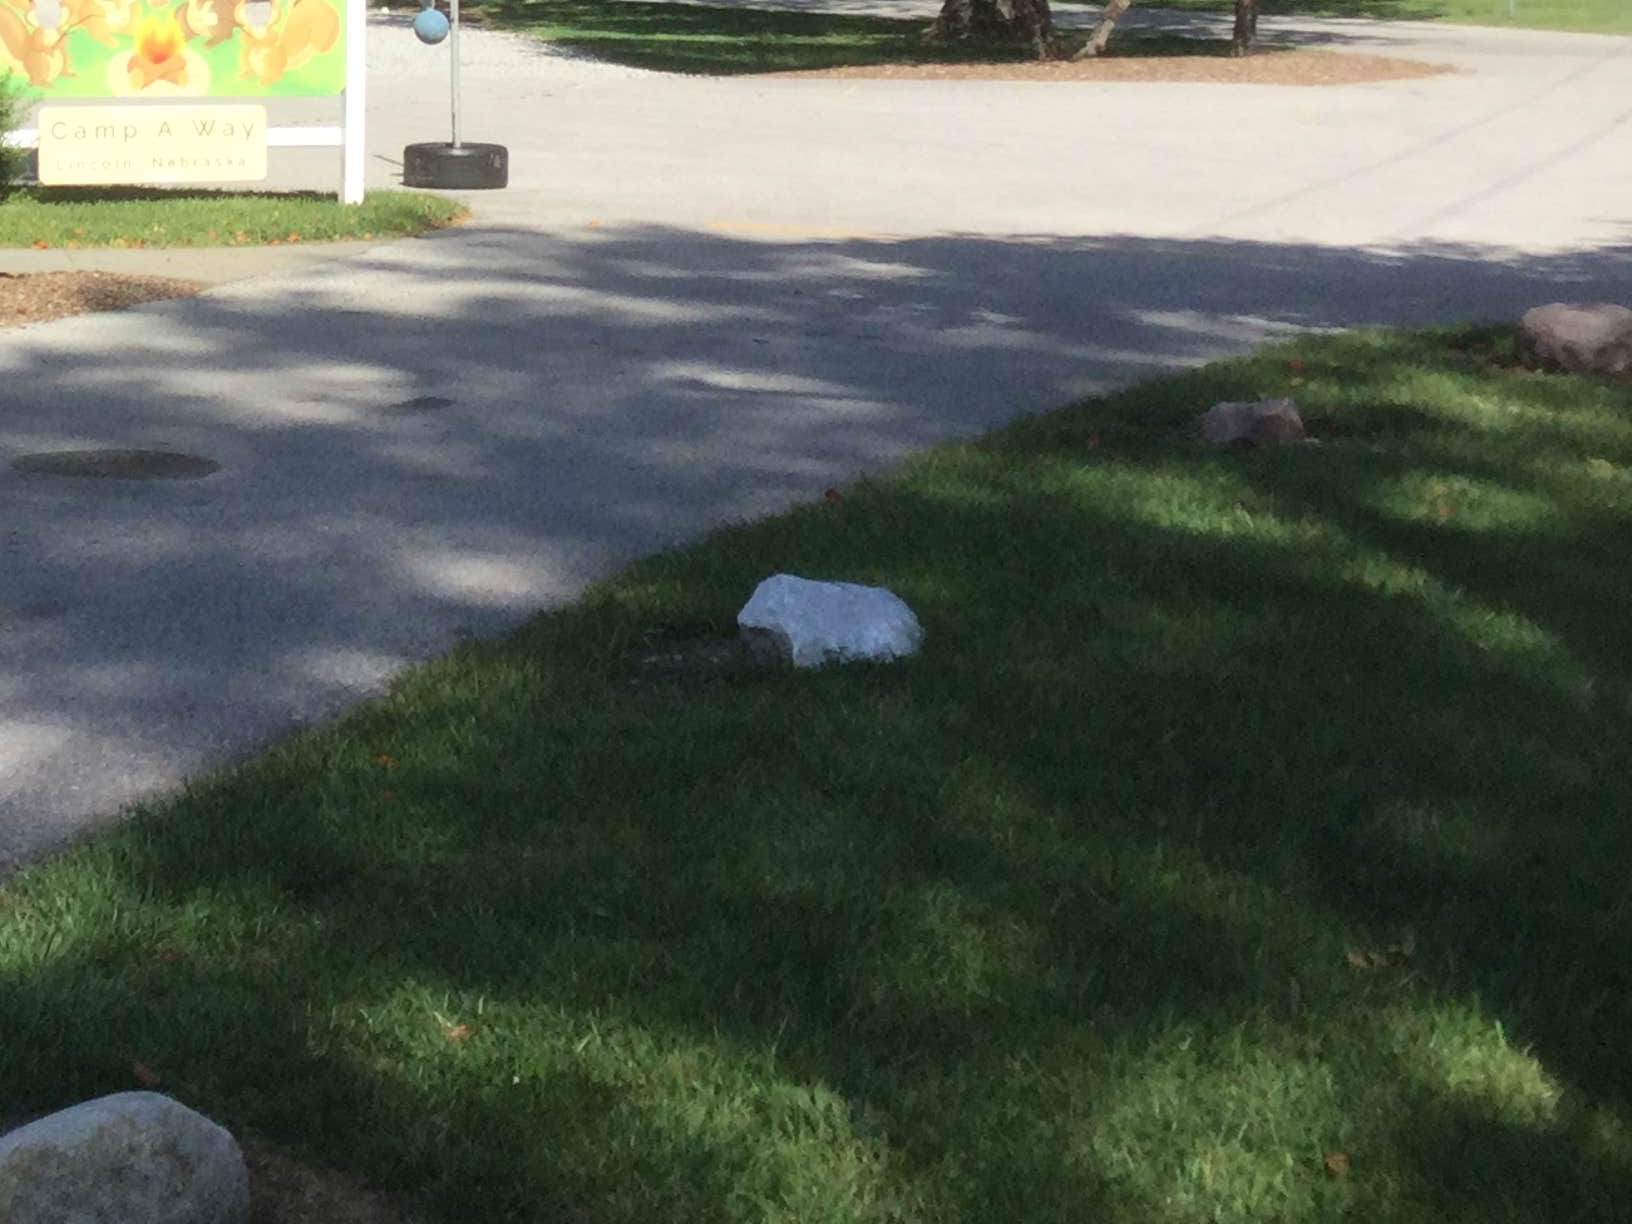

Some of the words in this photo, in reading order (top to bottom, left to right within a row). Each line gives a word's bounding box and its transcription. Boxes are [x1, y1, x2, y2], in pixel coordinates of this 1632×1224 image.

[50, 120, 138, 142] Camp
[157, 120, 173, 137] A
[191, 118, 255, 141] Way
[151, 155, 247, 169] Nebraska
